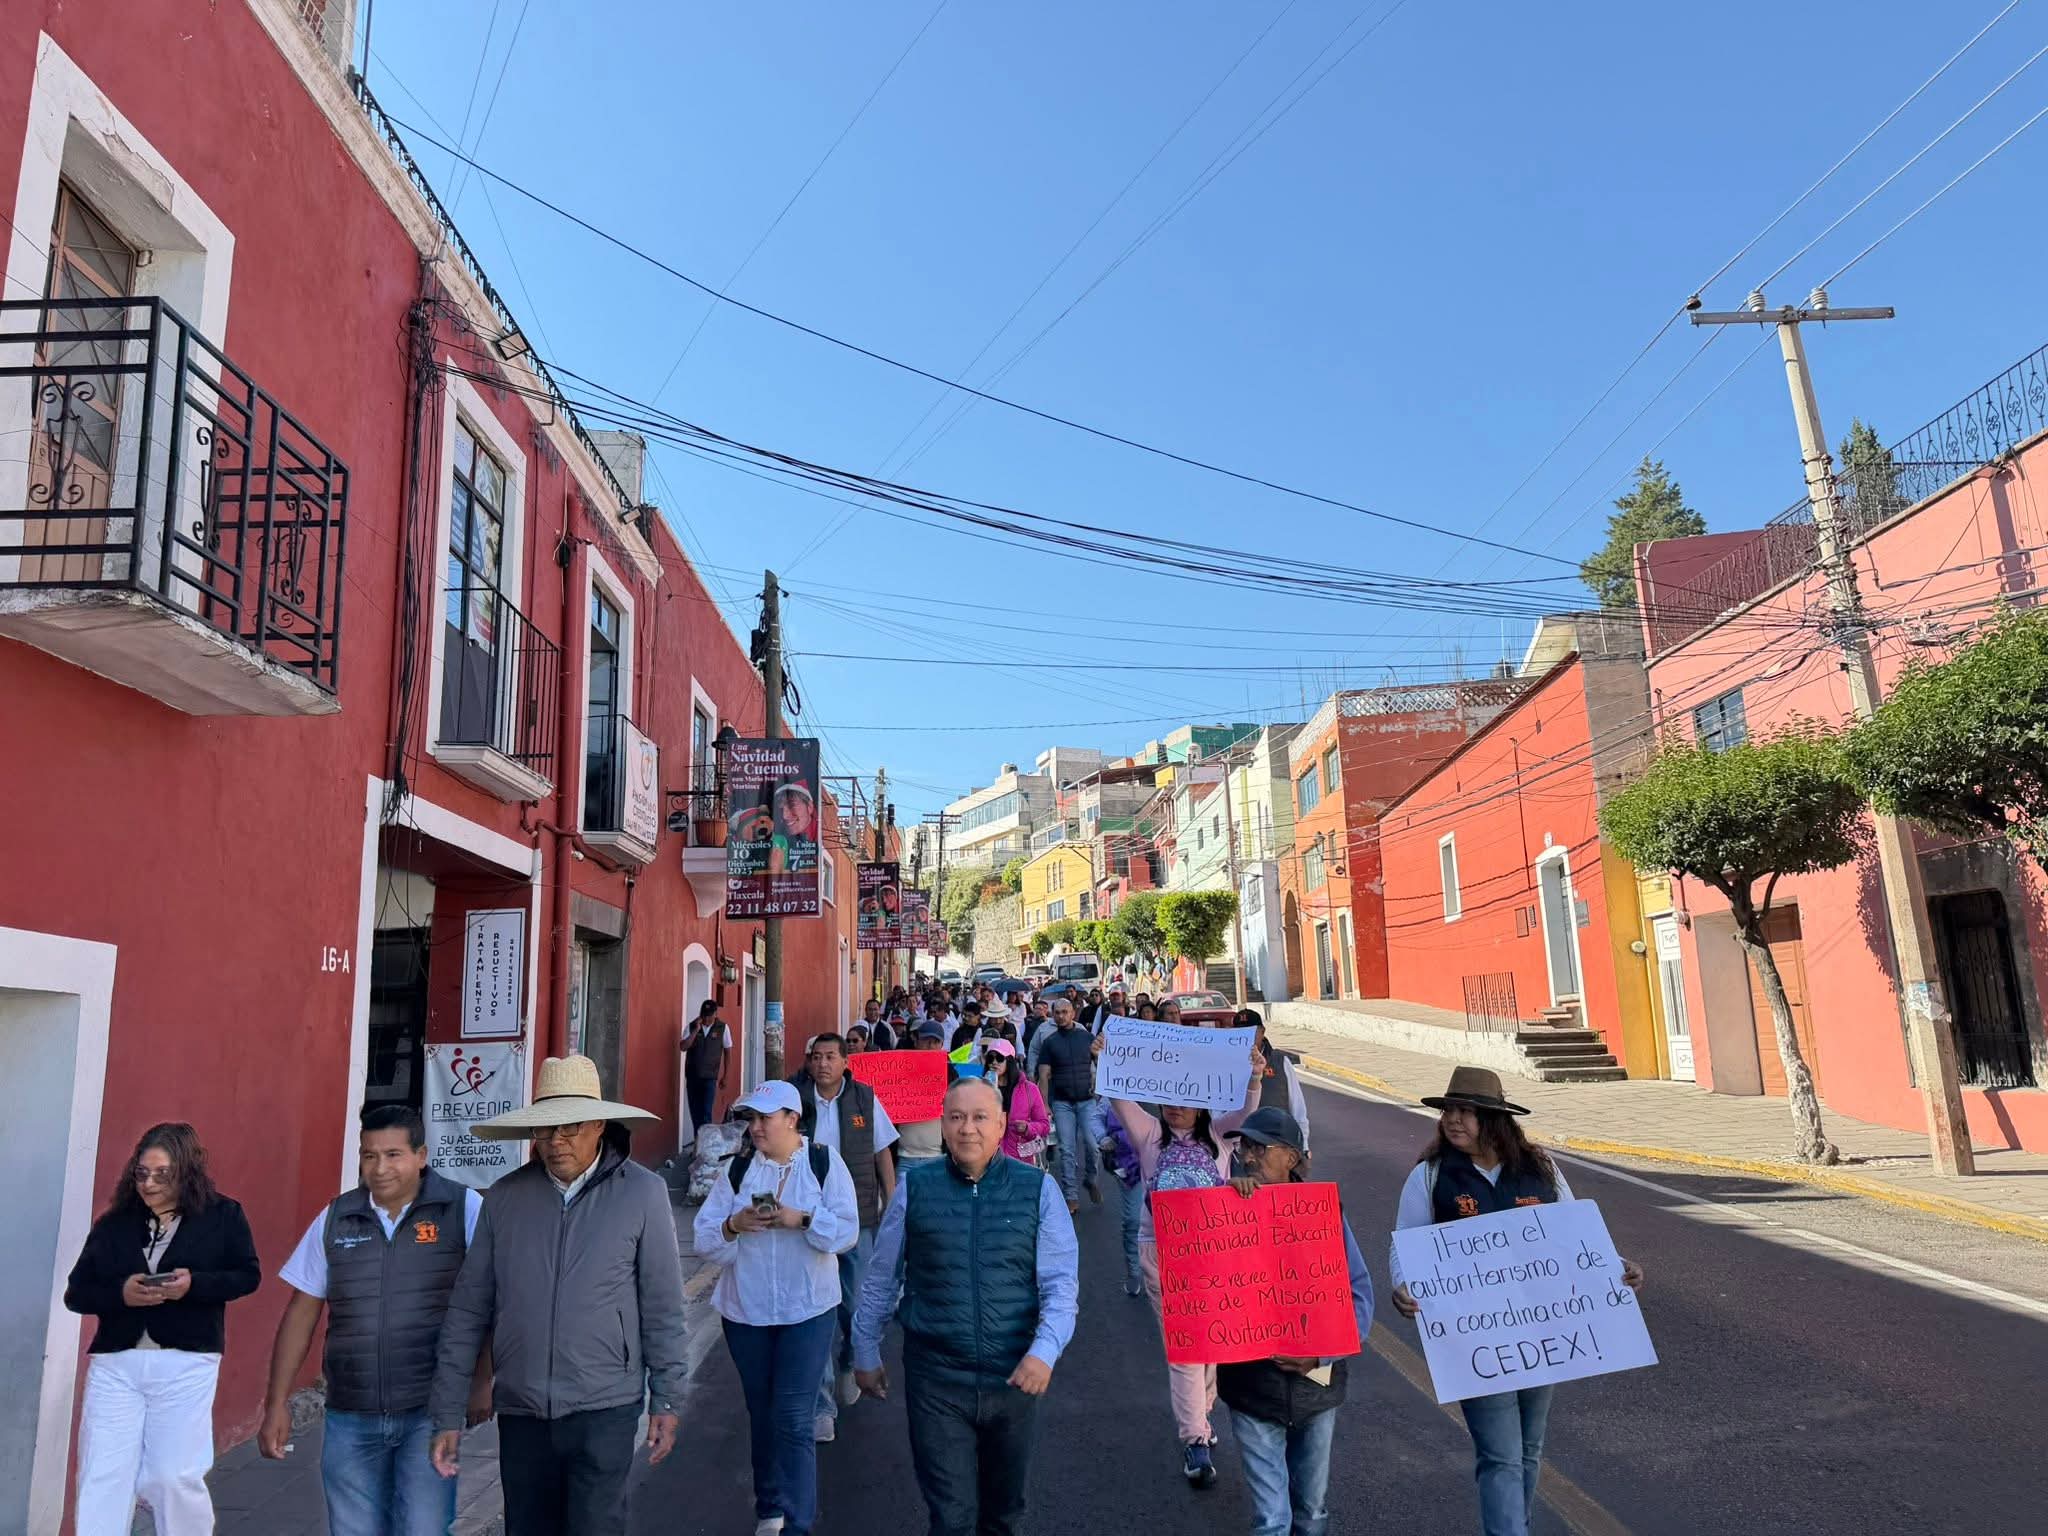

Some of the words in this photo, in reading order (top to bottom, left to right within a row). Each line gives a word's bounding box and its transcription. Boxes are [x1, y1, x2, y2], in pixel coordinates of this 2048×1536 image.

[730, 748, 785, 762] Navidad
[731, 764, 742, 772] de
[743, 763, 800, 775] Cuentos
[733, 849, 750, 859] 10
[727, 867, 753, 875] 2025
[728, 859, 766, 868] Diciembre
[789, 855, 800, 871] 7
[728, 890, 765, 900] Tlaxcala
[727, 904, 742, 915] 22
[746, 903, 760, 914] 11
[764, 902, 780, 913] 48
[783, 901, 798, 912] 07
[801, 900, 817, 912] 32
[320, 945, 350, 975] 16-A
[474, 924, 485, 1022] TRATAMIENTOS
[490, 932, 500, 1017] REDUCTIVOS
[1228, 1035, 1250, 1047] en
[1105, 1039, 1146, 1066] lugar
[1152, 1041, 1180, 1064] de:
[432, 1100, 512, 1117] PREVENIR
[852, 1115, 865, 1127] 31
[440, 1135, 454, 1145] SU
[437, 1146, 452, 1157] DE
[454, 1144, 502, 1156] SEGUROS
[431, 1158, 446, 1168] DE
[448, 1156, 506, 1168] CONFIANZA
[1160, 1202, 1190, 1235] Por
[1196, 1197, 1259, 1232] Justicia
[1271, 1190, 1332, 1219] Laboral
[1169, 1230, 1260, 1258] continuidad
[1430, 1225, 1510, 1263] ¡Fuera
[1522, 1208, 1547, 1243] el
[1199, 1273, 1226, 1291] se
[1228, 1269, 1270, 1287] recree
[1279, 1258, 1298, 1281] la
[1409, 1257, 1560, 1301] autoritarismo
[1576, 1238, 1609, 1272] de
[1218, 1293, 1245, 1312] de
[1420, 1307, 1447, 1340] la
[1456, 1283, 1595, 1335] coordinación
[1606, 1276, 1633, 1308] de
[1166, 1328, 1195, 1349] nos
[1470, 1324, 1603, 1380] CEDEX!
